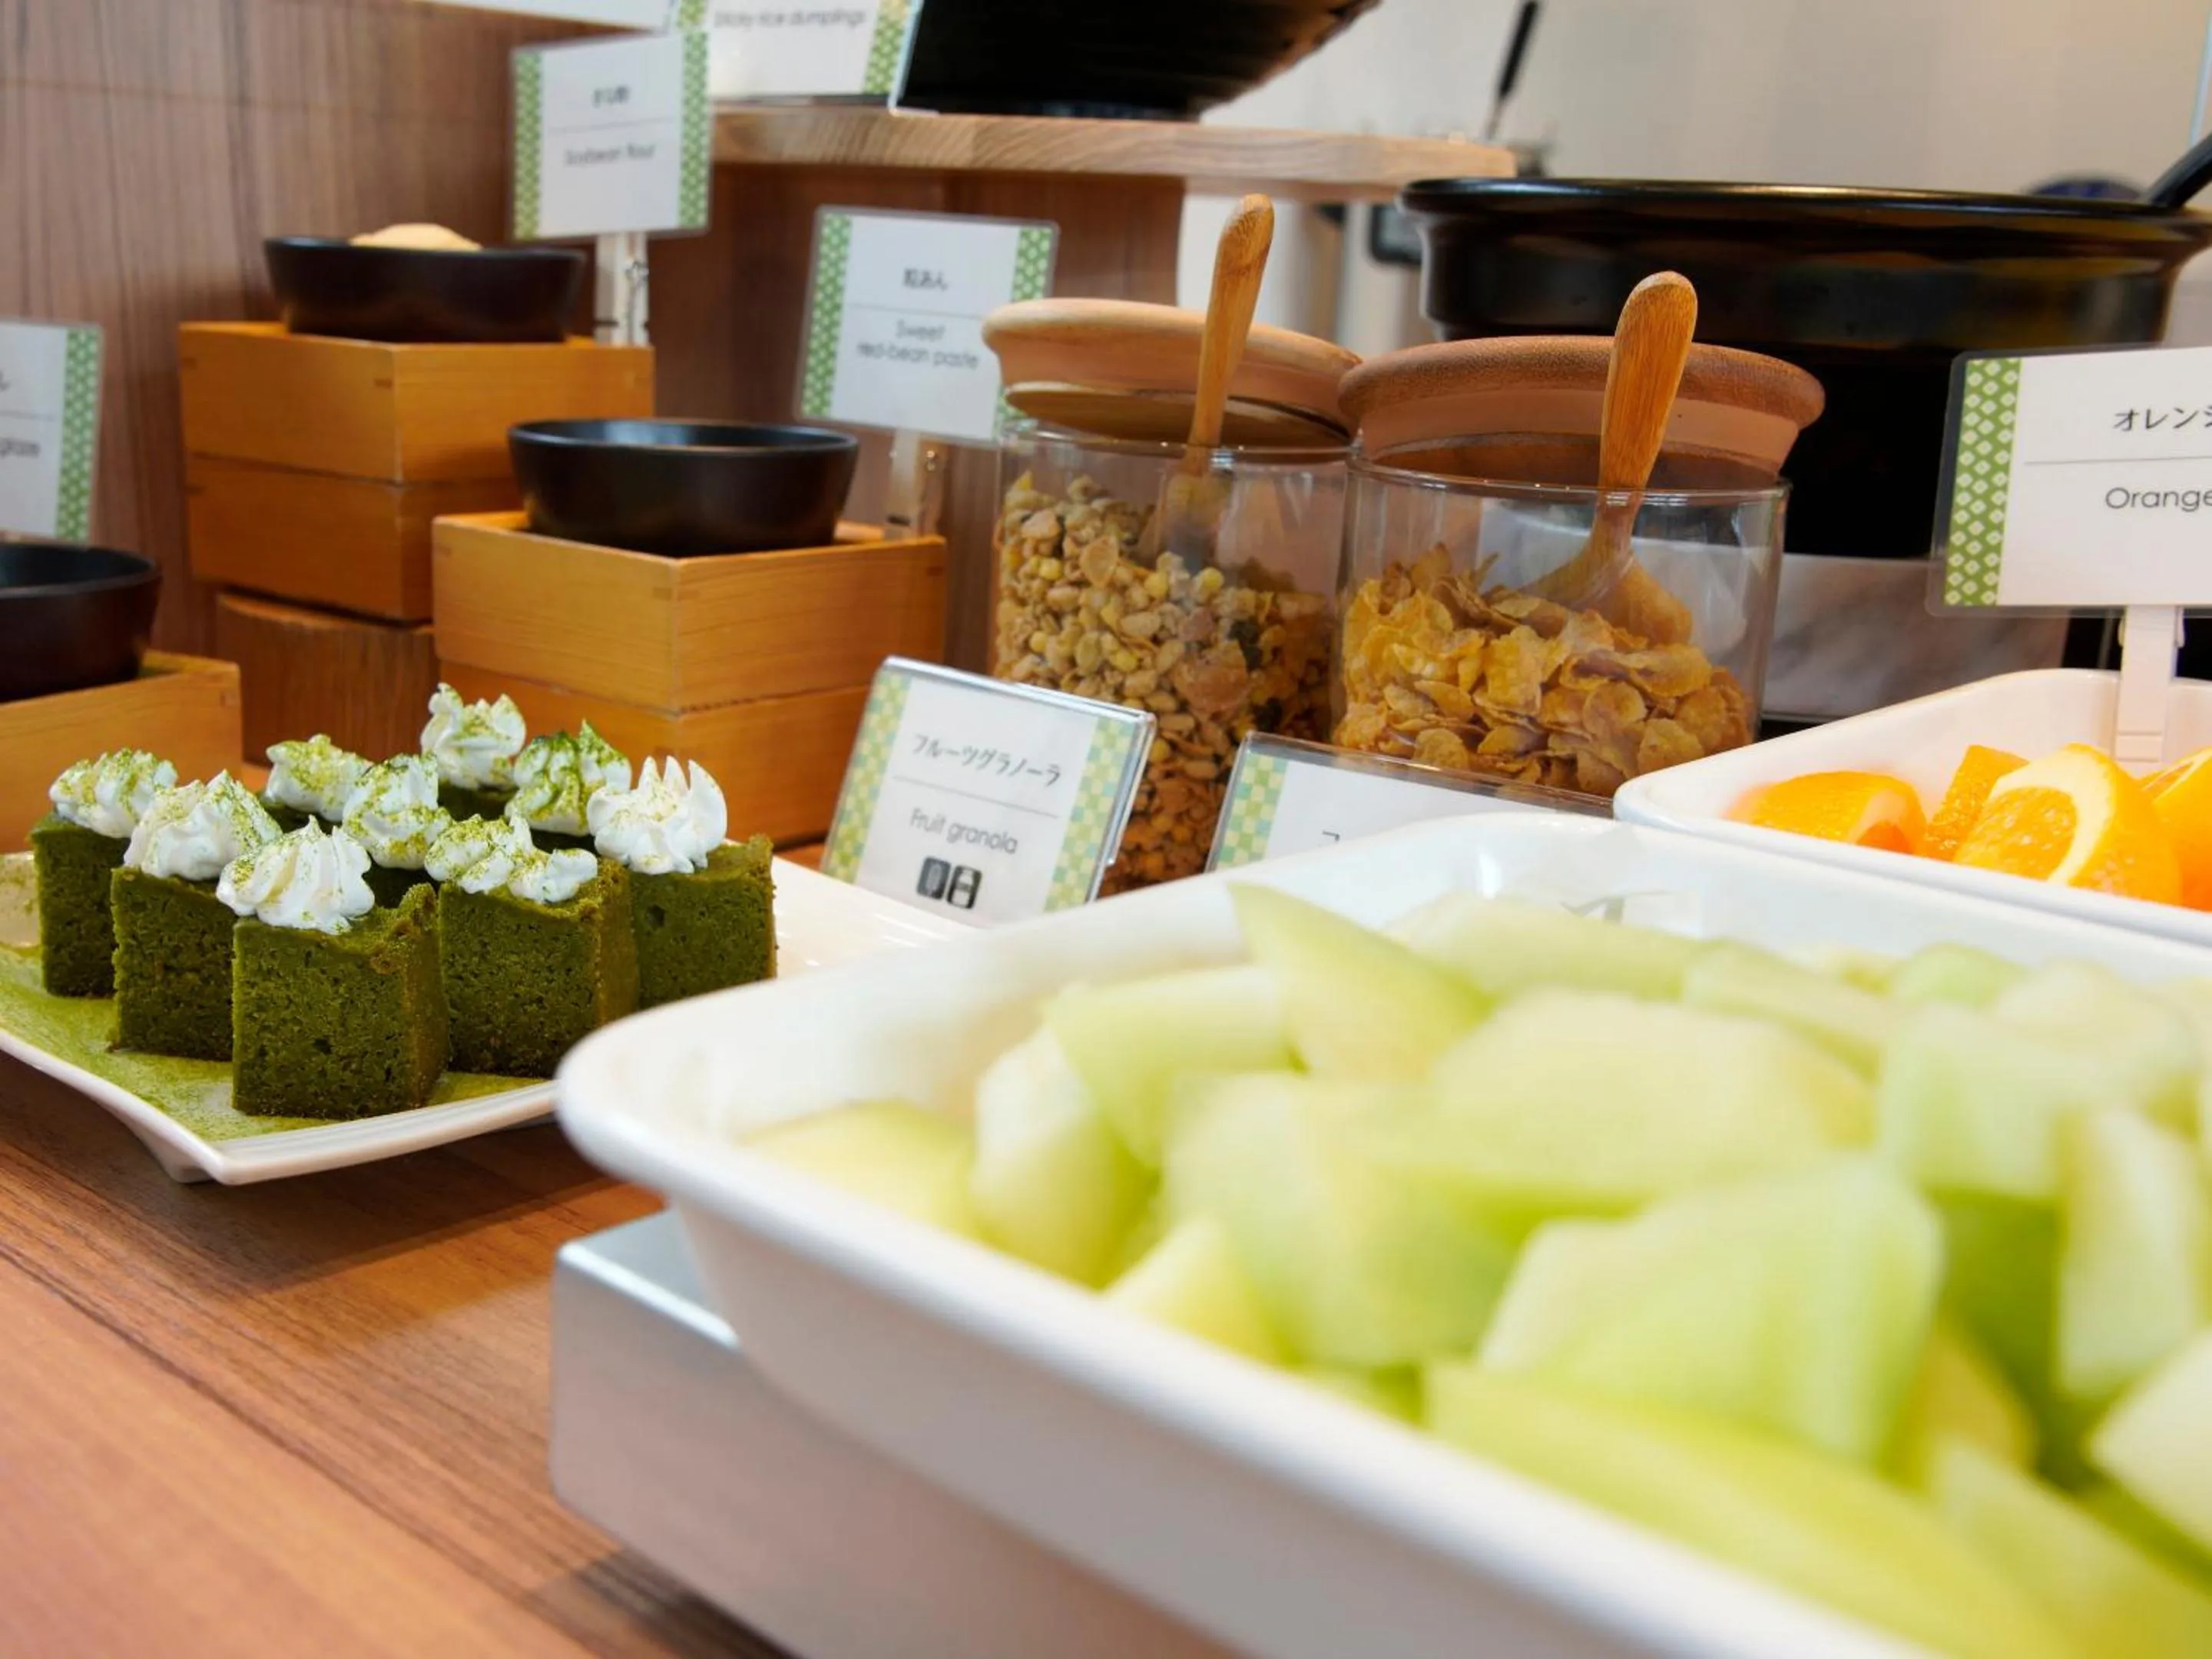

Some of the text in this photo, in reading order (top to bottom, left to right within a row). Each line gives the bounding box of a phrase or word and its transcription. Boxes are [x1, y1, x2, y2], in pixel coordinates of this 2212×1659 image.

[912, 733, 1061, 786] フルーツグラノーラ
[910, 807, 1018, 854] Fruit granola
